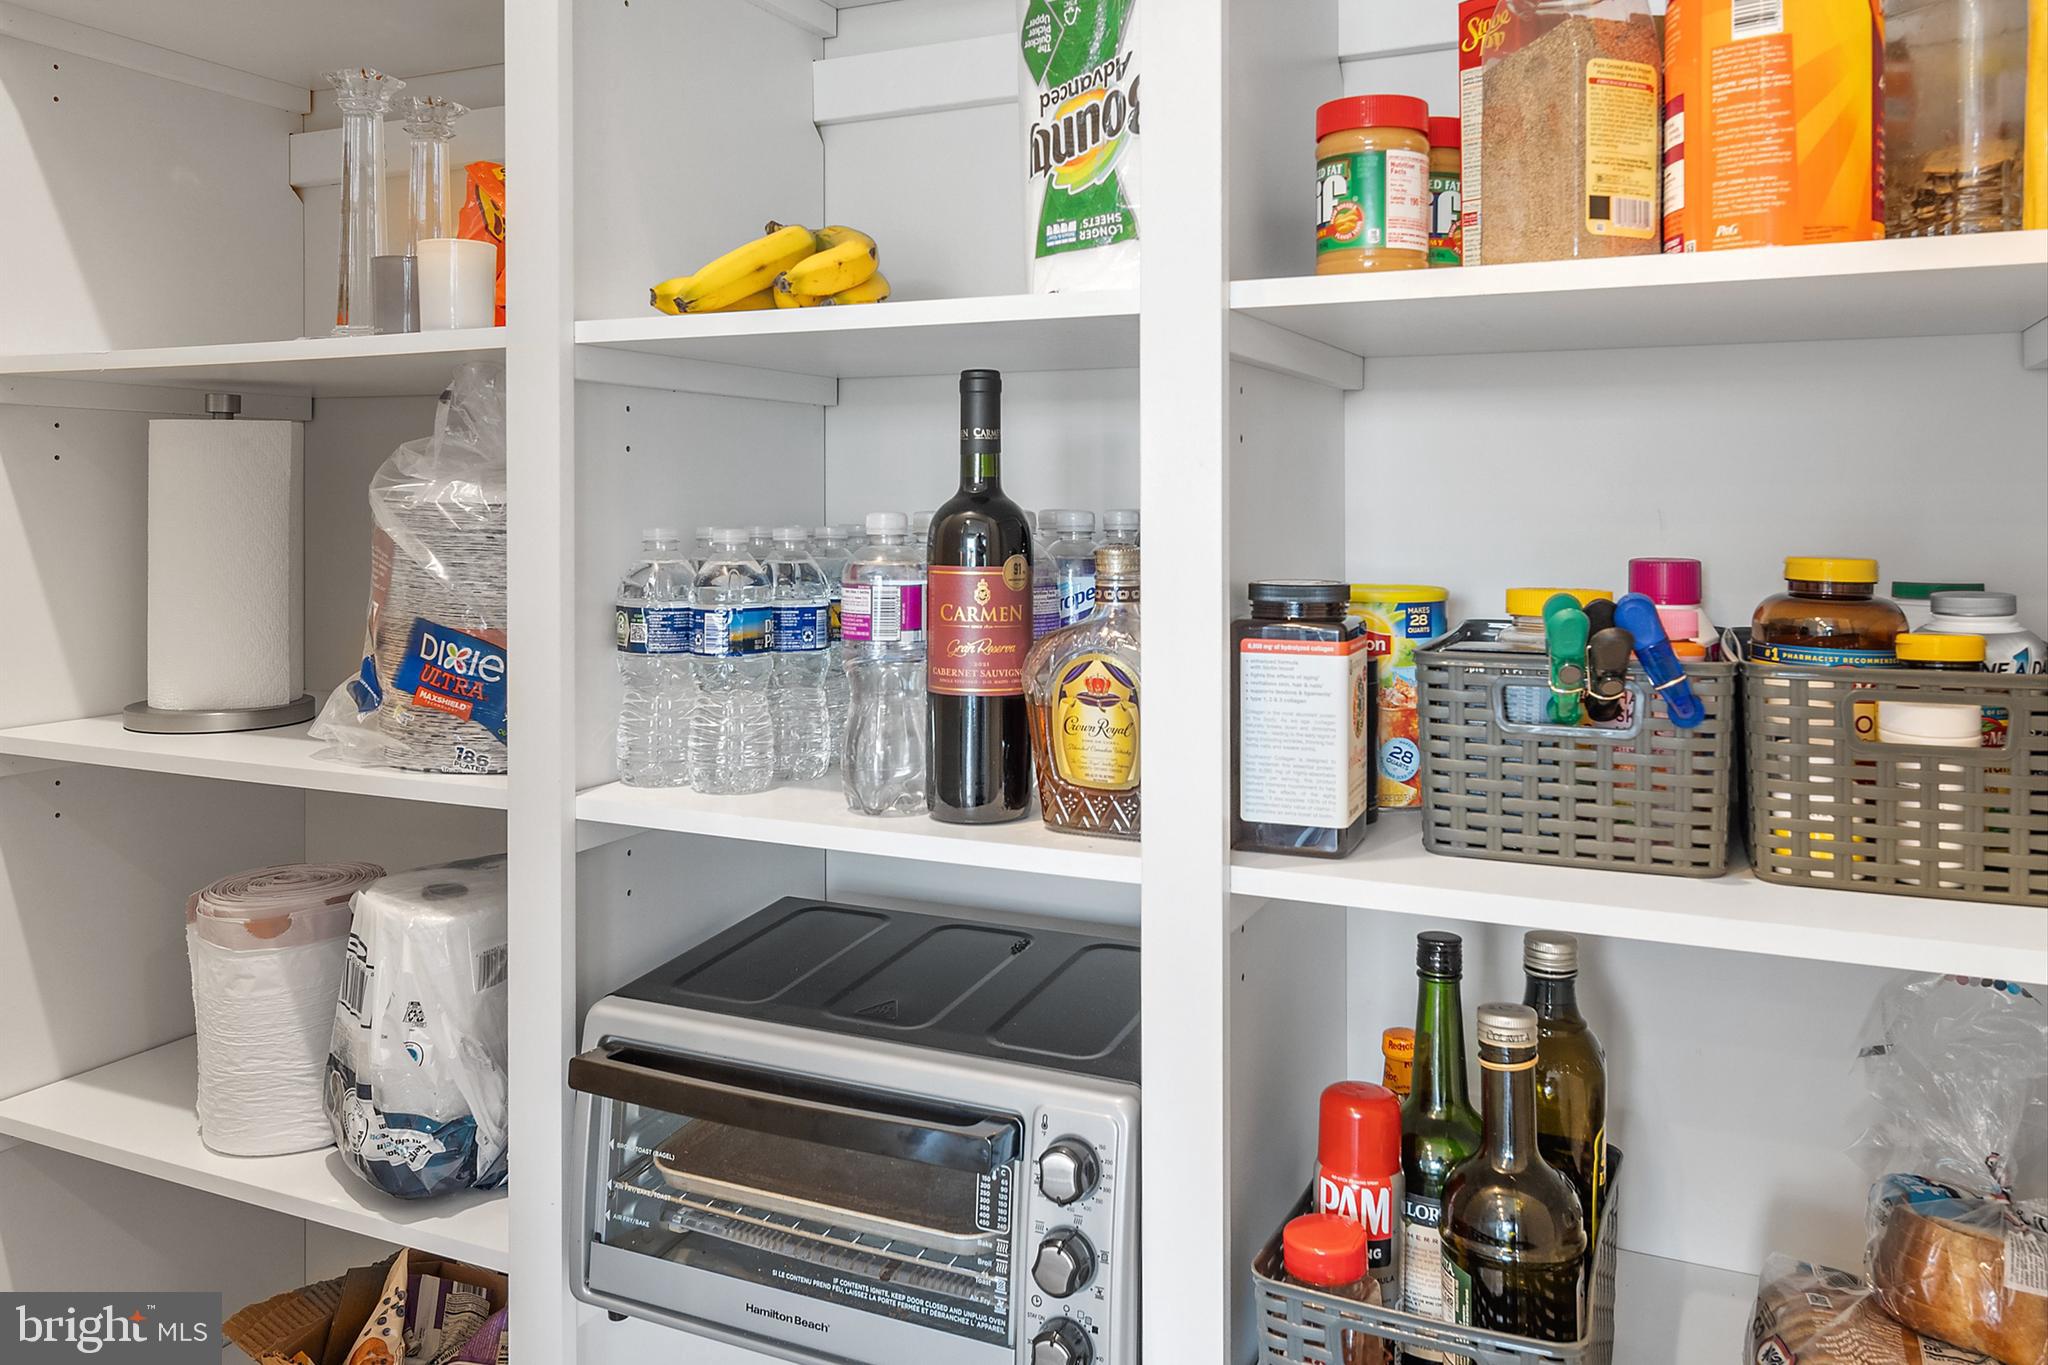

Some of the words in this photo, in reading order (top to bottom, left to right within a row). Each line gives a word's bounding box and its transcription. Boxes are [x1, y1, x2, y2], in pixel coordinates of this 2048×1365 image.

[1028, 13, 1051, 29] Upper
[1028, 24, 1051, 37] Picker
[1461, 9, 1511, 52] Stove
[1024, 33, 1051, 49] Quicker
[1037, 43, 1051, 53] The
[1040, 50, 1133, 117] Advanced
[1327, 163, 1343, 176] FAT
[1445, 180, 1461, 192] FAT
[1079, 224, 1123, 240] LONGER
[973, 427, 1000, 437] CARM
[1013, 562, 1022, 575] 91
[1060, 586, 1096, 611] rope
[940, 603, 1023, 622] CARMEN
[1407, 606, 1430, 614] MAKES
[1410, 614, 1428, 626] 28
[1407, 626, 1430, 634] QUARTS
[946, 638, 976, 658] Gran
[975, 637, 1016, 656] Reserva
[1782, 652, 1840, 663] PHARMACIST
[932, 666, 978, 679] CABERNET
[419, 663, 485, 700] ULTRA
[419, 690, 467, 711] MAXSHIELD
[1064, 715, 1095, 735] Crown
[1089, 718, 1134, 739] Royal
[455, 746, 489, 767] 186
[1389, 746, 1414, 764] 28
[454, 760, 487, 773] PLATES
[1386, 757, 1410, 771] QUARTS
[1487, 1029, 1530, 1043] COLAVITA
[653, 1150, 675, 1161] (BAGEL)
[1320, 1176, 1390, 1236] PAM
[1407, 1201, 1440, 1221] LOR
[623, 1215, 650, 1228] FRY/BAKE
[977, 1240, 992, 1249] Bake
[1407, 1232, 1439, 1245] HERR
[977, 1257, 992, 1267] Broil
[975, 1276, 992, 1286] Toast
[785, 1272, 812, 1285] CONTENU
[812, 1279, 831, 1290] PREND
[832, 1284, 845, 1294] FEU,
[845, 1288, 868, 1299] LAISSEZ
[868, 1293, 877, 1302] LA
[877, 1296, 896, 1307] PORTE
[921, 1307, 929, 1315] ET
[840, 1279, 869, 1291] CONTENTS
[870, 1286, 890, 1297] IGNITE,
[891, 1292, 906, 1301] KEEP
[906, 1295, 924, 1306] DOOR
[925, 1299, 948, 1312] CLOSED
[949, 1307, 962, 1316] AND
[963, 1310, 988, 1322] UNPLUG
[989, 1316, 1006, 1326] OVEN
[980, 1296, 991, 1306] Fry
[745, 1302, 793, 1324] Hamilton
[794, 1316, 829, 1333] Beach
